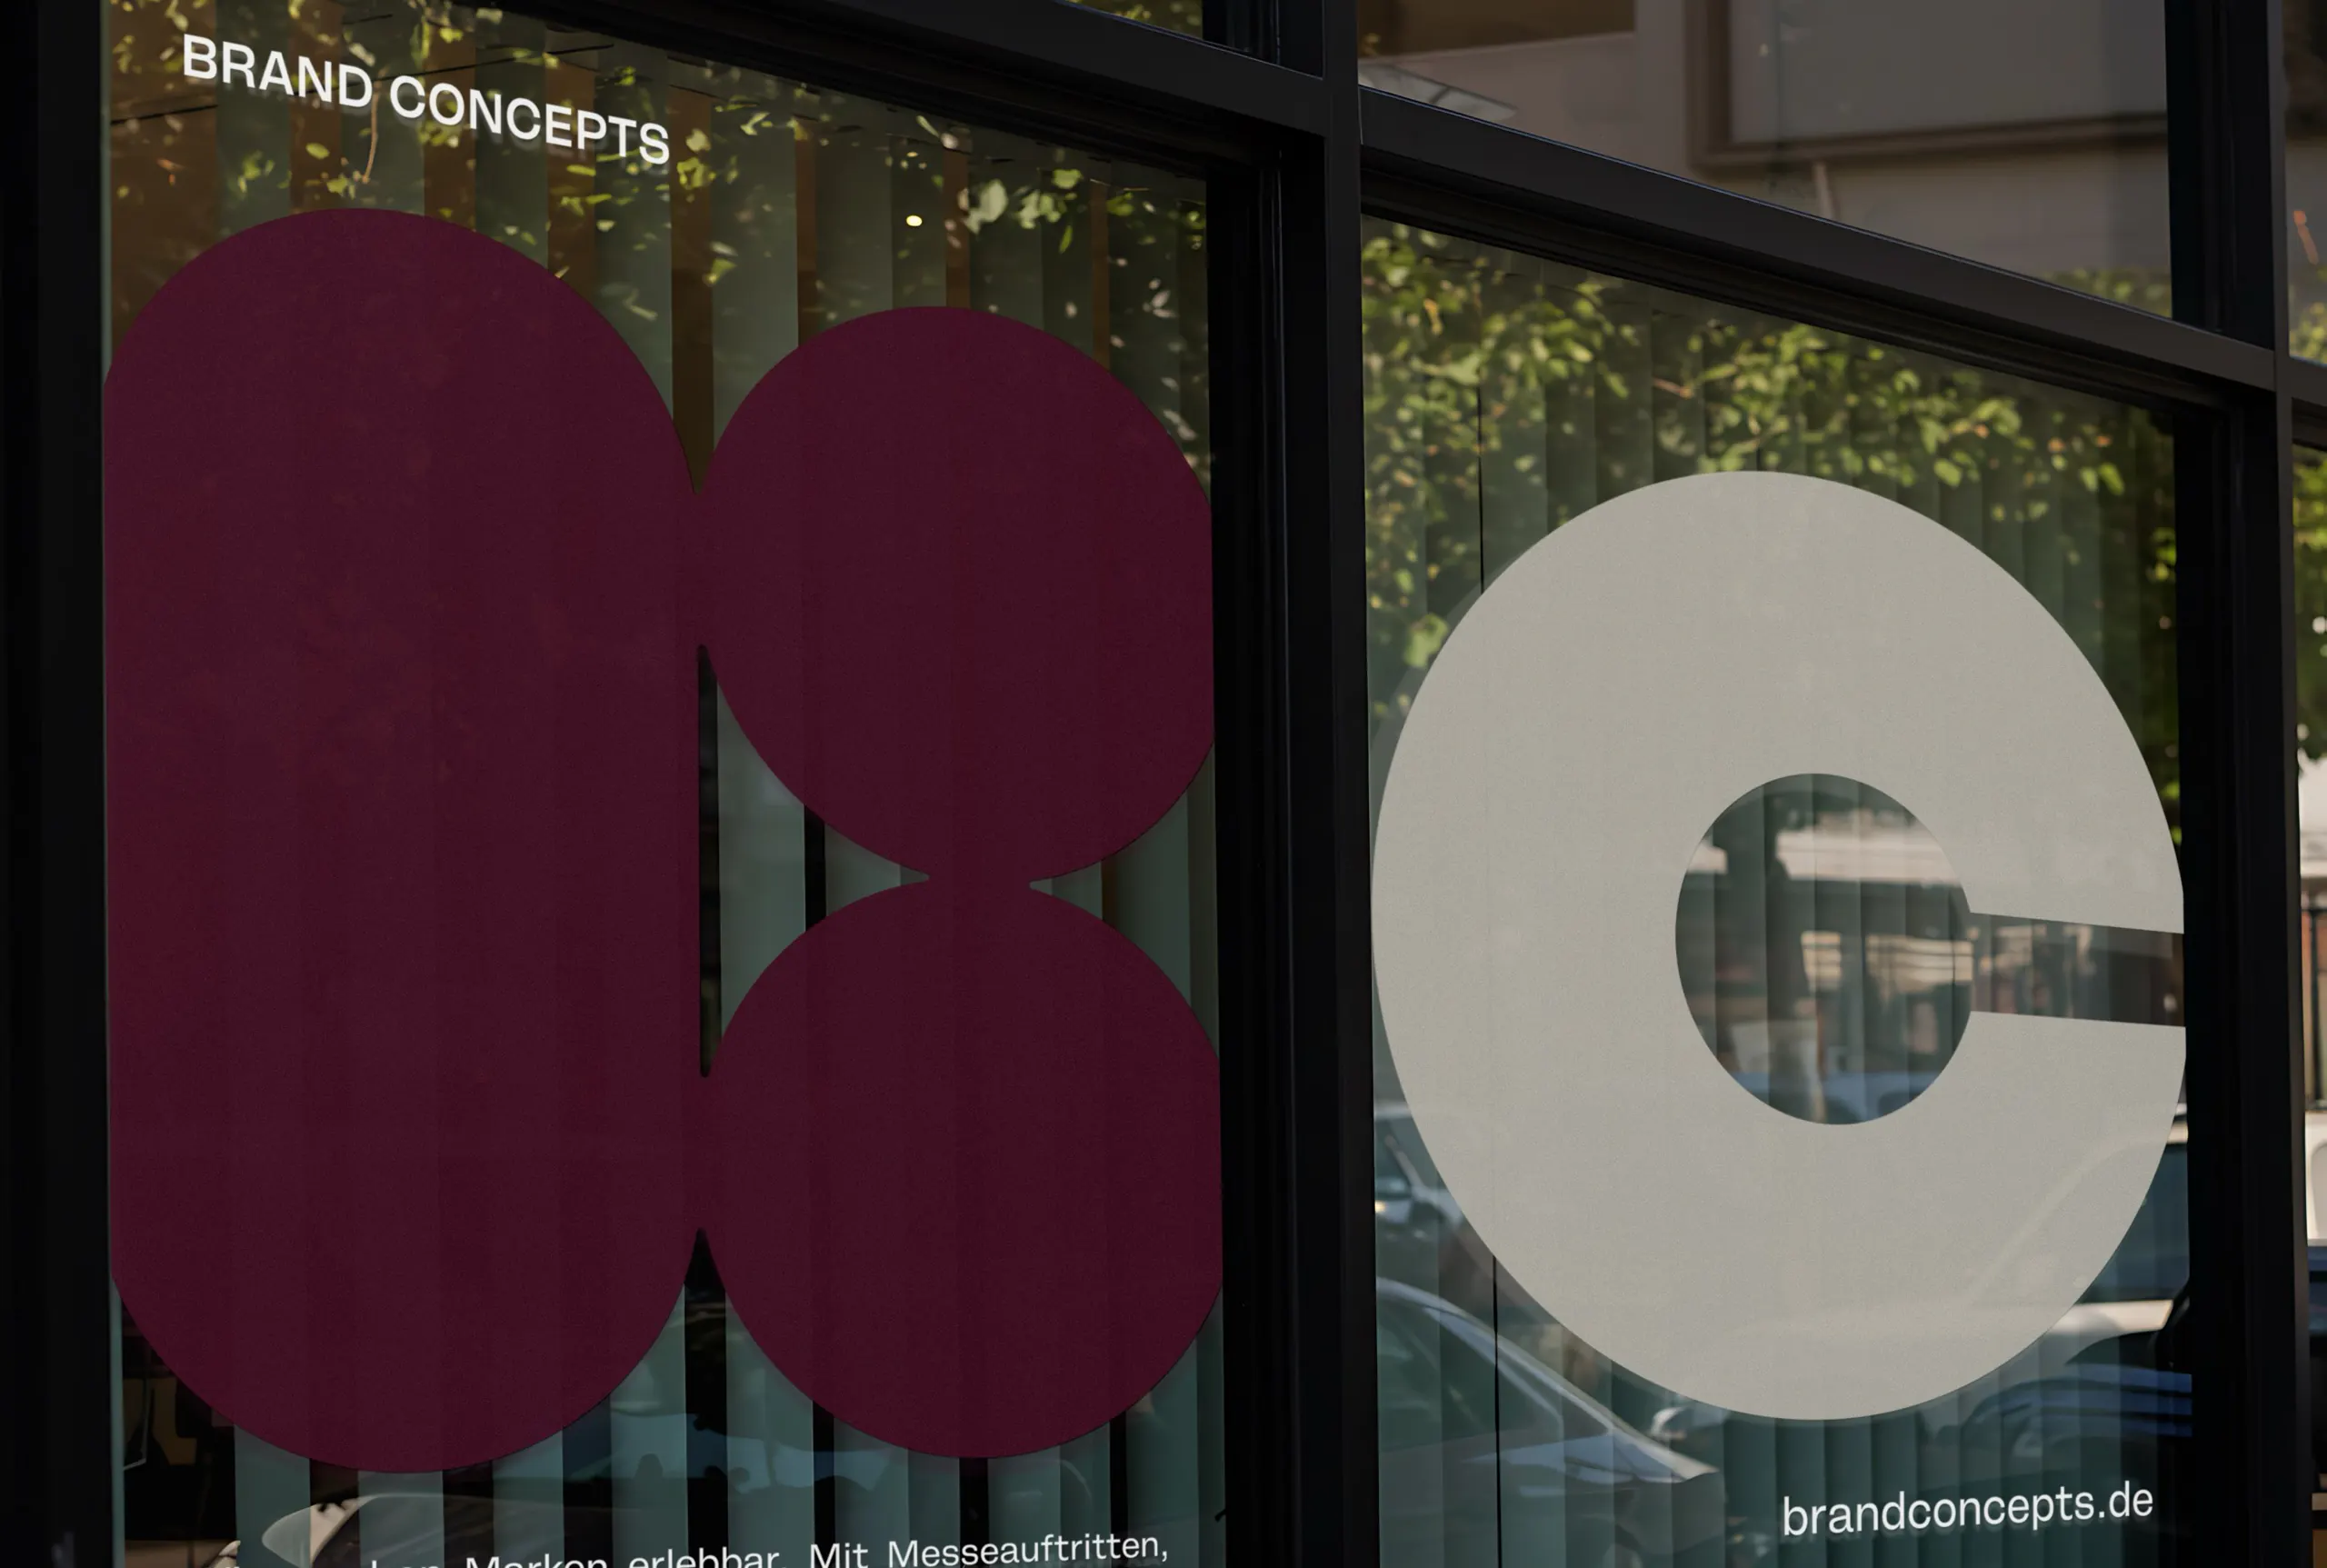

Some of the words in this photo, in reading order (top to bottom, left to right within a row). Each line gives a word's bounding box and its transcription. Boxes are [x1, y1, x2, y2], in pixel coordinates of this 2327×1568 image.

[184, 34, 374, 108] BRAND
[389, 75, 671, 165] CONCEPTS
[1783, 1480, 2154, 1536] brandconcepts.de
[809, 1542, 870, 1568] Mit
[887, 1533, 1168, 1568] Messeauftritten,
